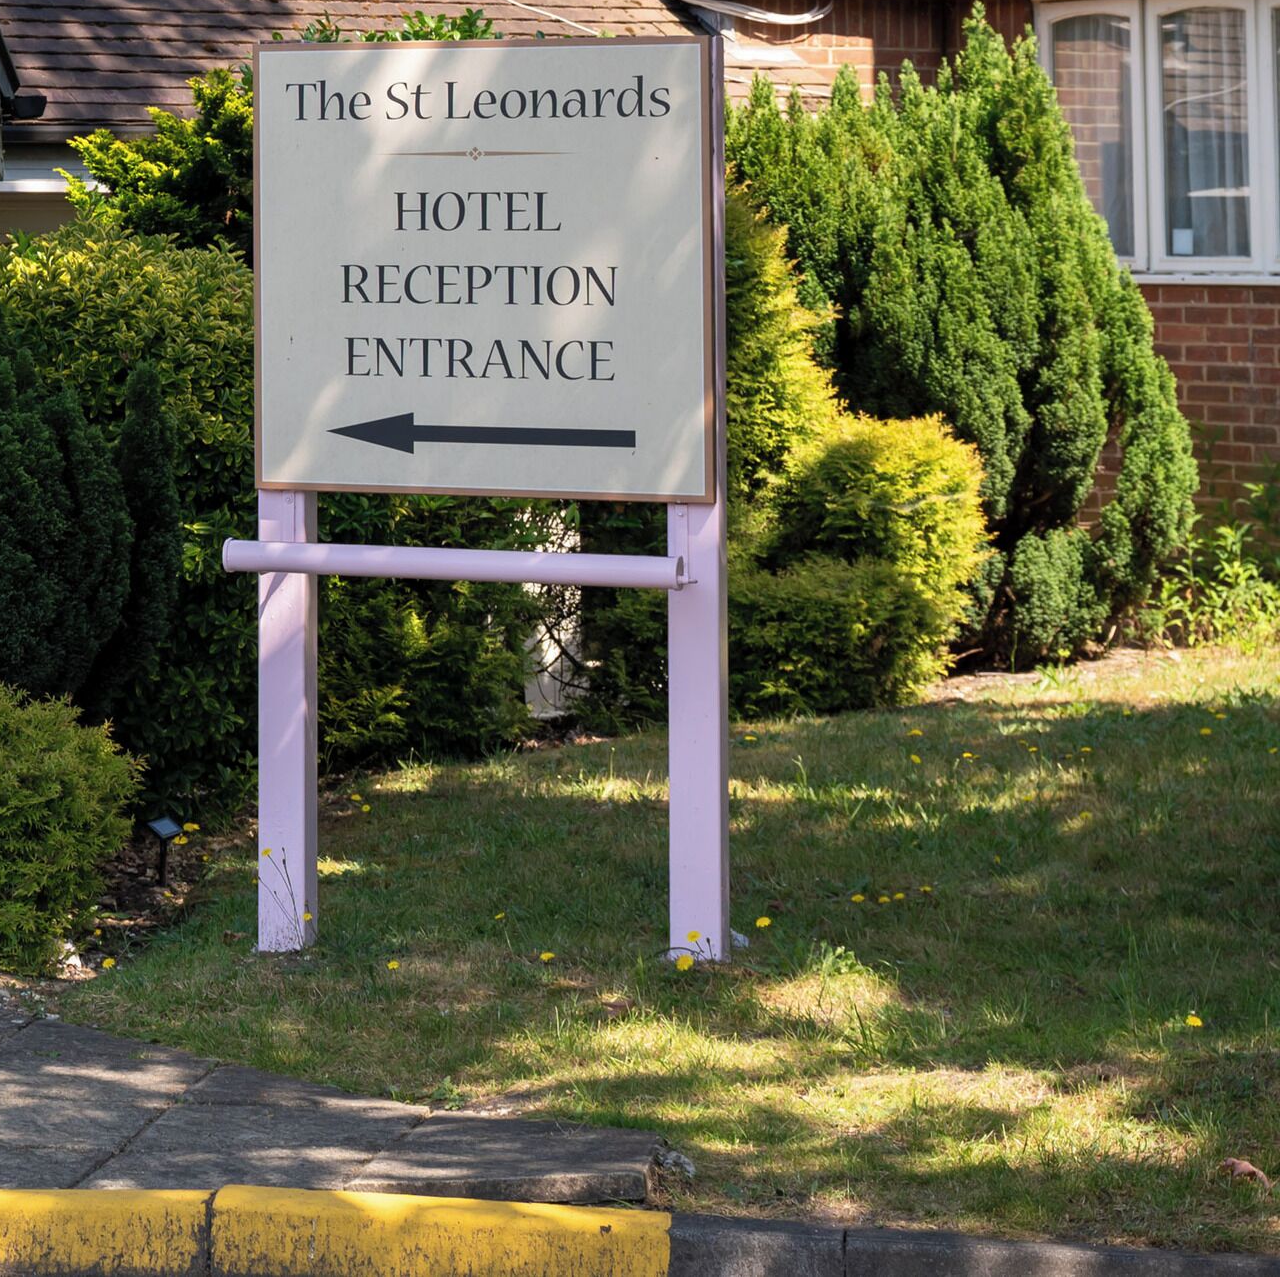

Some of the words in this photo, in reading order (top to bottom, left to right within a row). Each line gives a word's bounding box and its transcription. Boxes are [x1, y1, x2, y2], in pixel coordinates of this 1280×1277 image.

[285, 79, 372, 122] The
[385, 80, 432, 122] St
[443, 74, 671, 121] Leonards
[393, 190, 562, 232] HOTEL
[341, 263, 617, 307] RECEPTION
[344, 336, 616, 383] ENTRANCE
